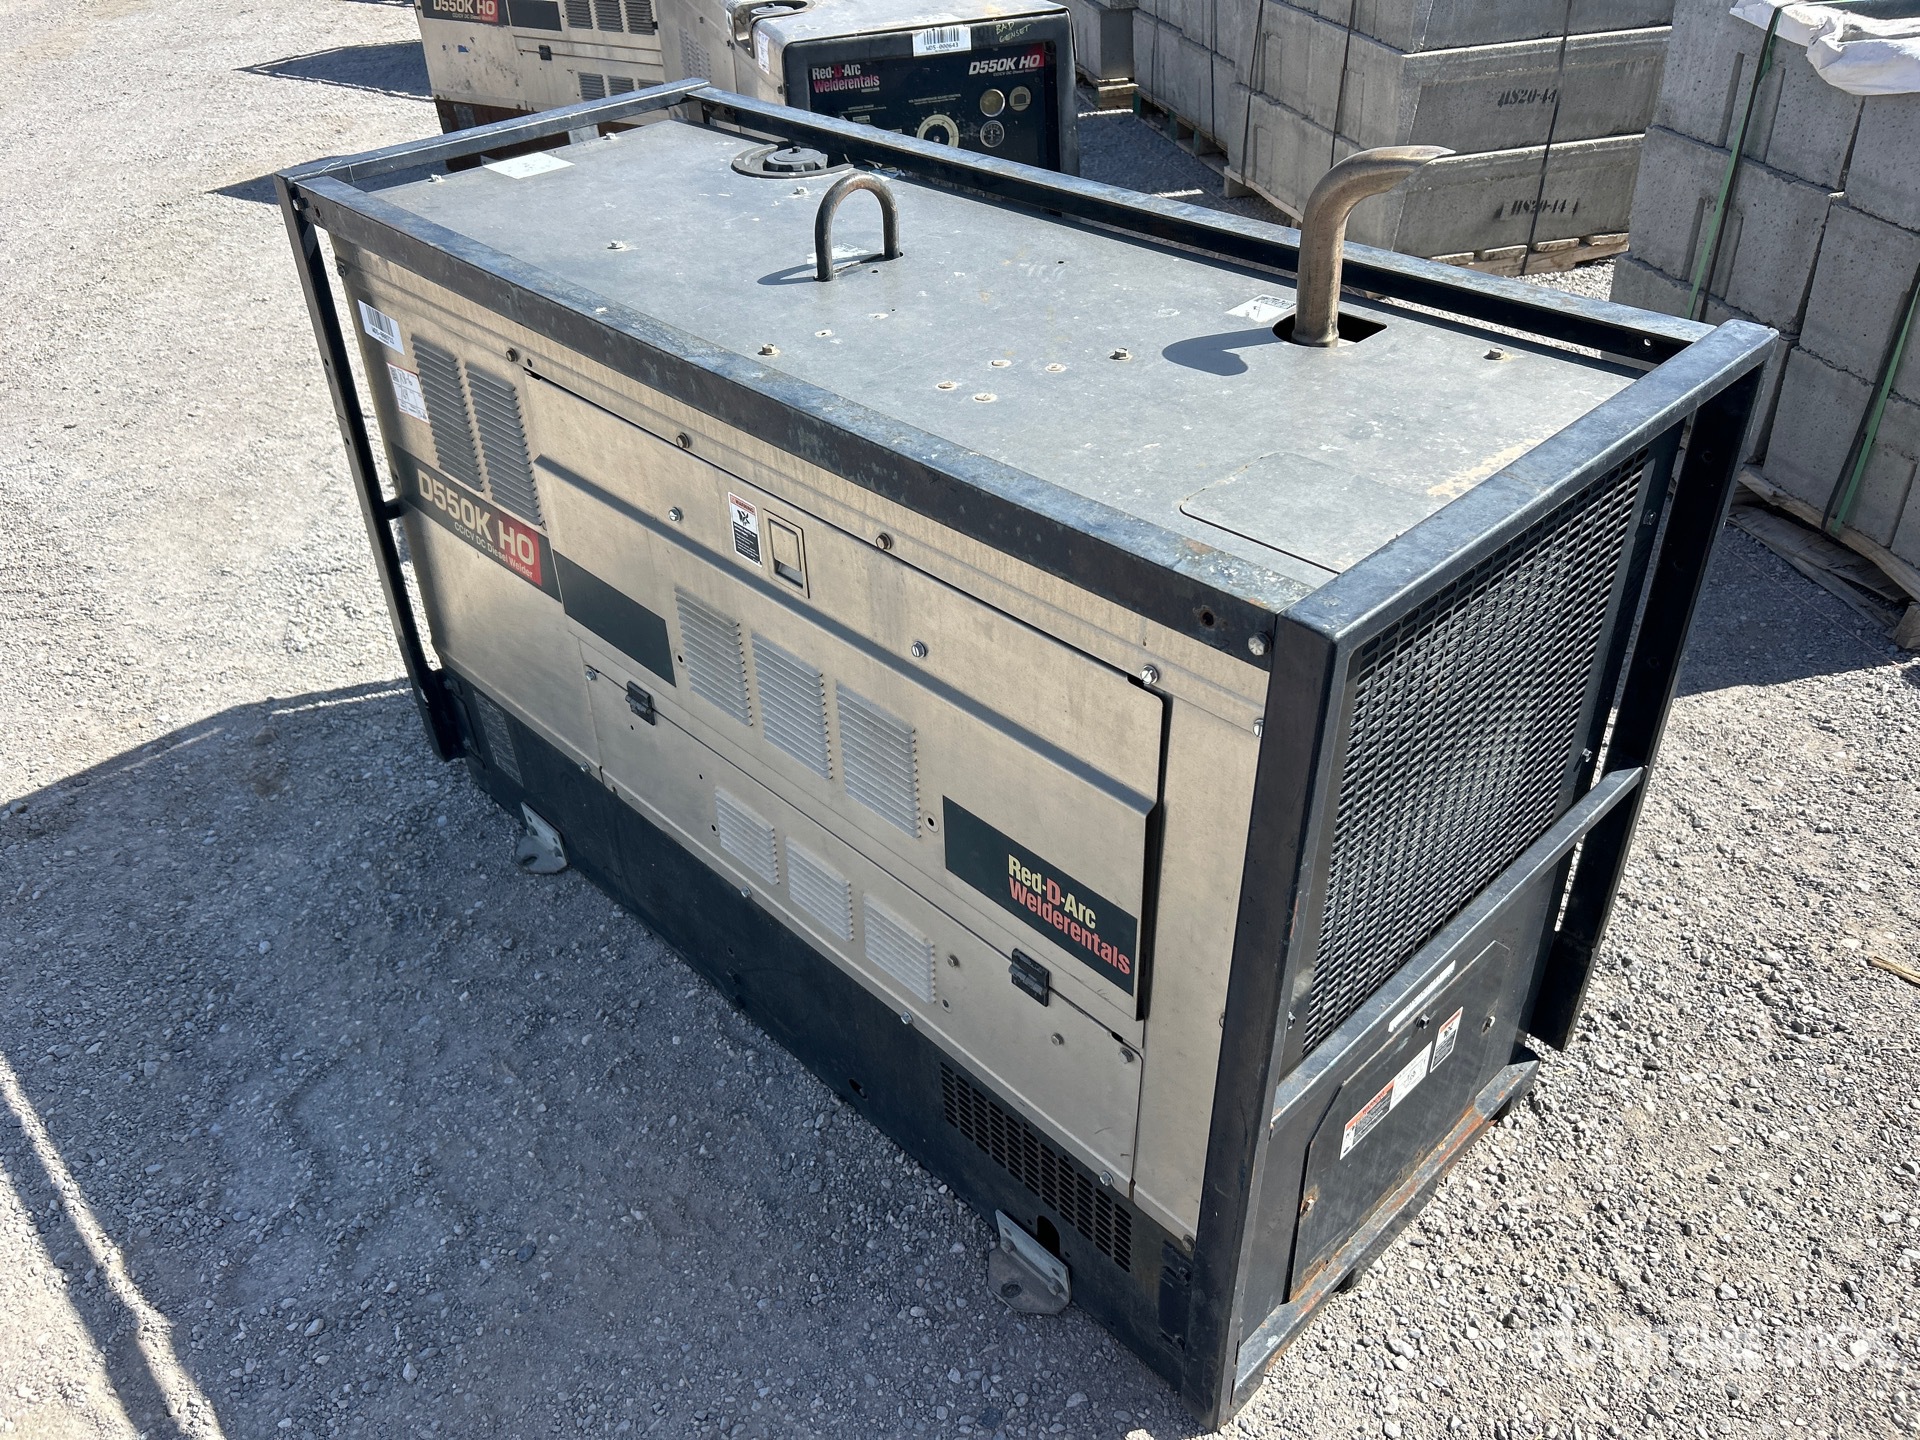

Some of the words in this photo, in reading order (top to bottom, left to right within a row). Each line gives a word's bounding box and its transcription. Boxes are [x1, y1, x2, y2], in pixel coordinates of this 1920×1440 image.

[433, 0, 474, 14] D550K
[476, 0, 495, 15] HO
[996, 21, 1015, 35] BAD
[968, 57, 1018, 76] D550K
[1018, 54, 1041, 69] HO
[813, 75, 880, 94] Welderentals
[417, 468, 494, 543] D550K
[498, 519, 536, 567] HO
[475, 534, 487, 549] DC
[487, 543, 509, 563] Diesel
[508, 555, 533, 579] Welder
[1008, 853, 1097, 930] Red-D-Arc
[1008, 876, 1131, 976] Welderentals
